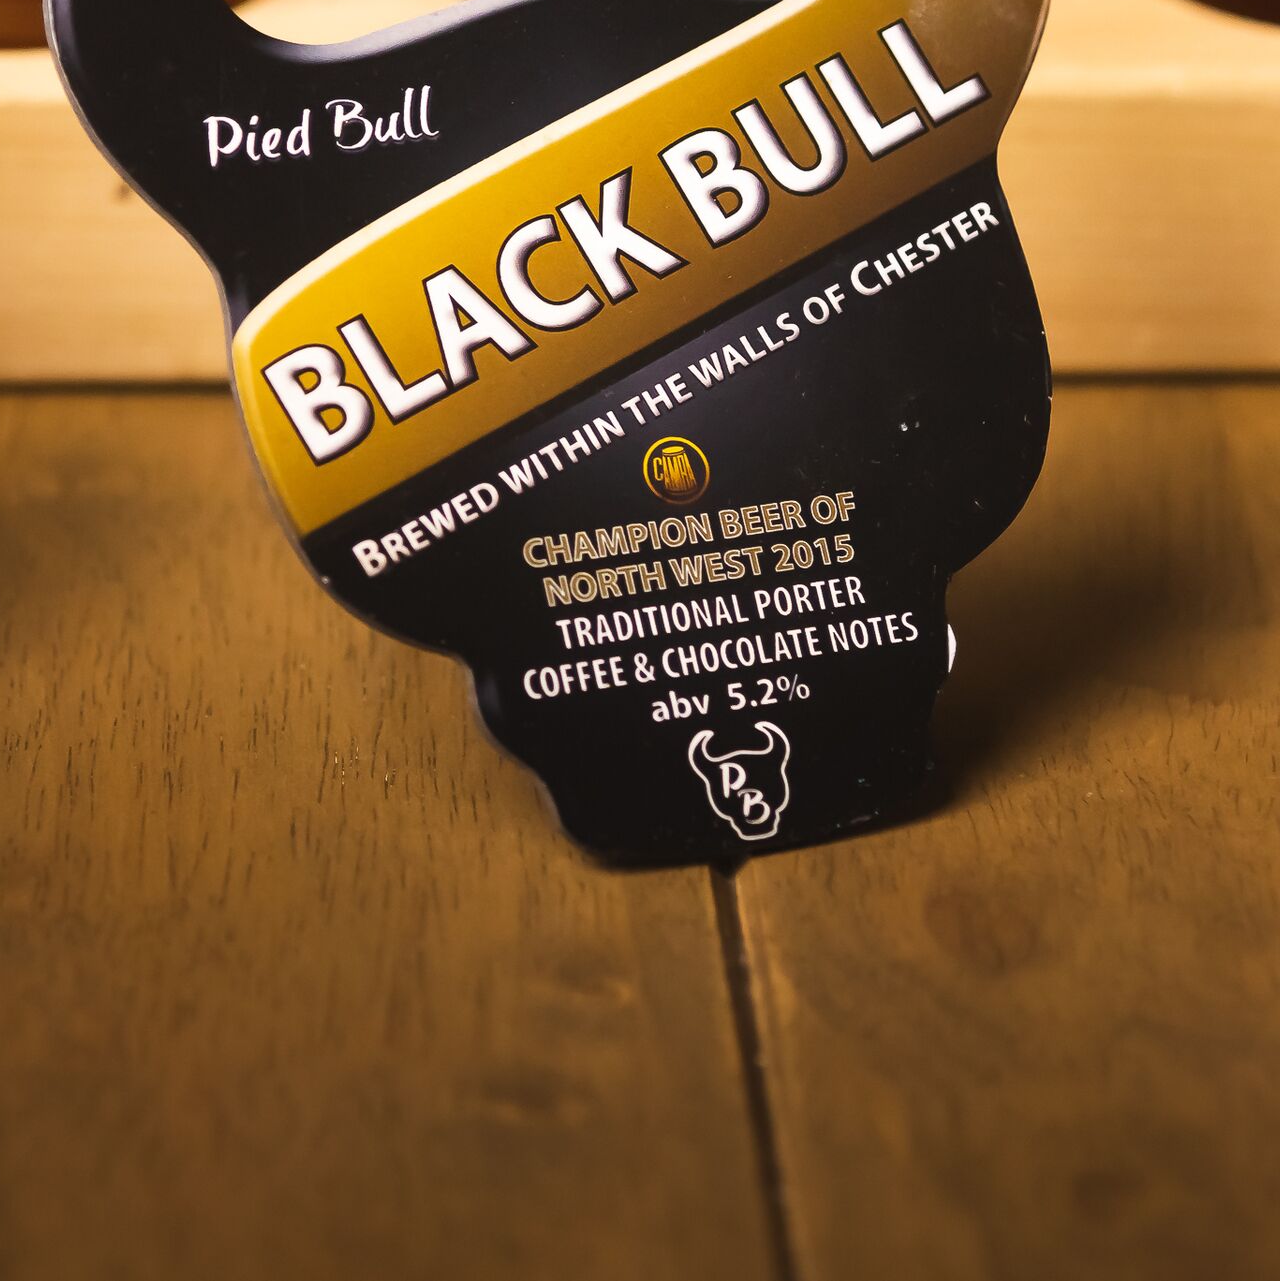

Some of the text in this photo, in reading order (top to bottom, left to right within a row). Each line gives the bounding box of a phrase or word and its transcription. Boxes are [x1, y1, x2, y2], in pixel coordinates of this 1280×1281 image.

[203, 84, 440, 170] Pied Bull
[260, 20, 993, 468] BLACK BULL
[350, 200, 1001, 579] BREWED WITHIN THE WALLS OF CHESTER
[522, 491, 857, 569] CHAMPION BEER OF
[543, 534, 855, 607] NORTH WEST 2015
[555, 576, 866, 649] TRADITIONAL PORTER
[523, 612, 920, 701] COFFEE & CHOCOLATE NOTES
[651, 674, 811, 722] abv 5.2%
